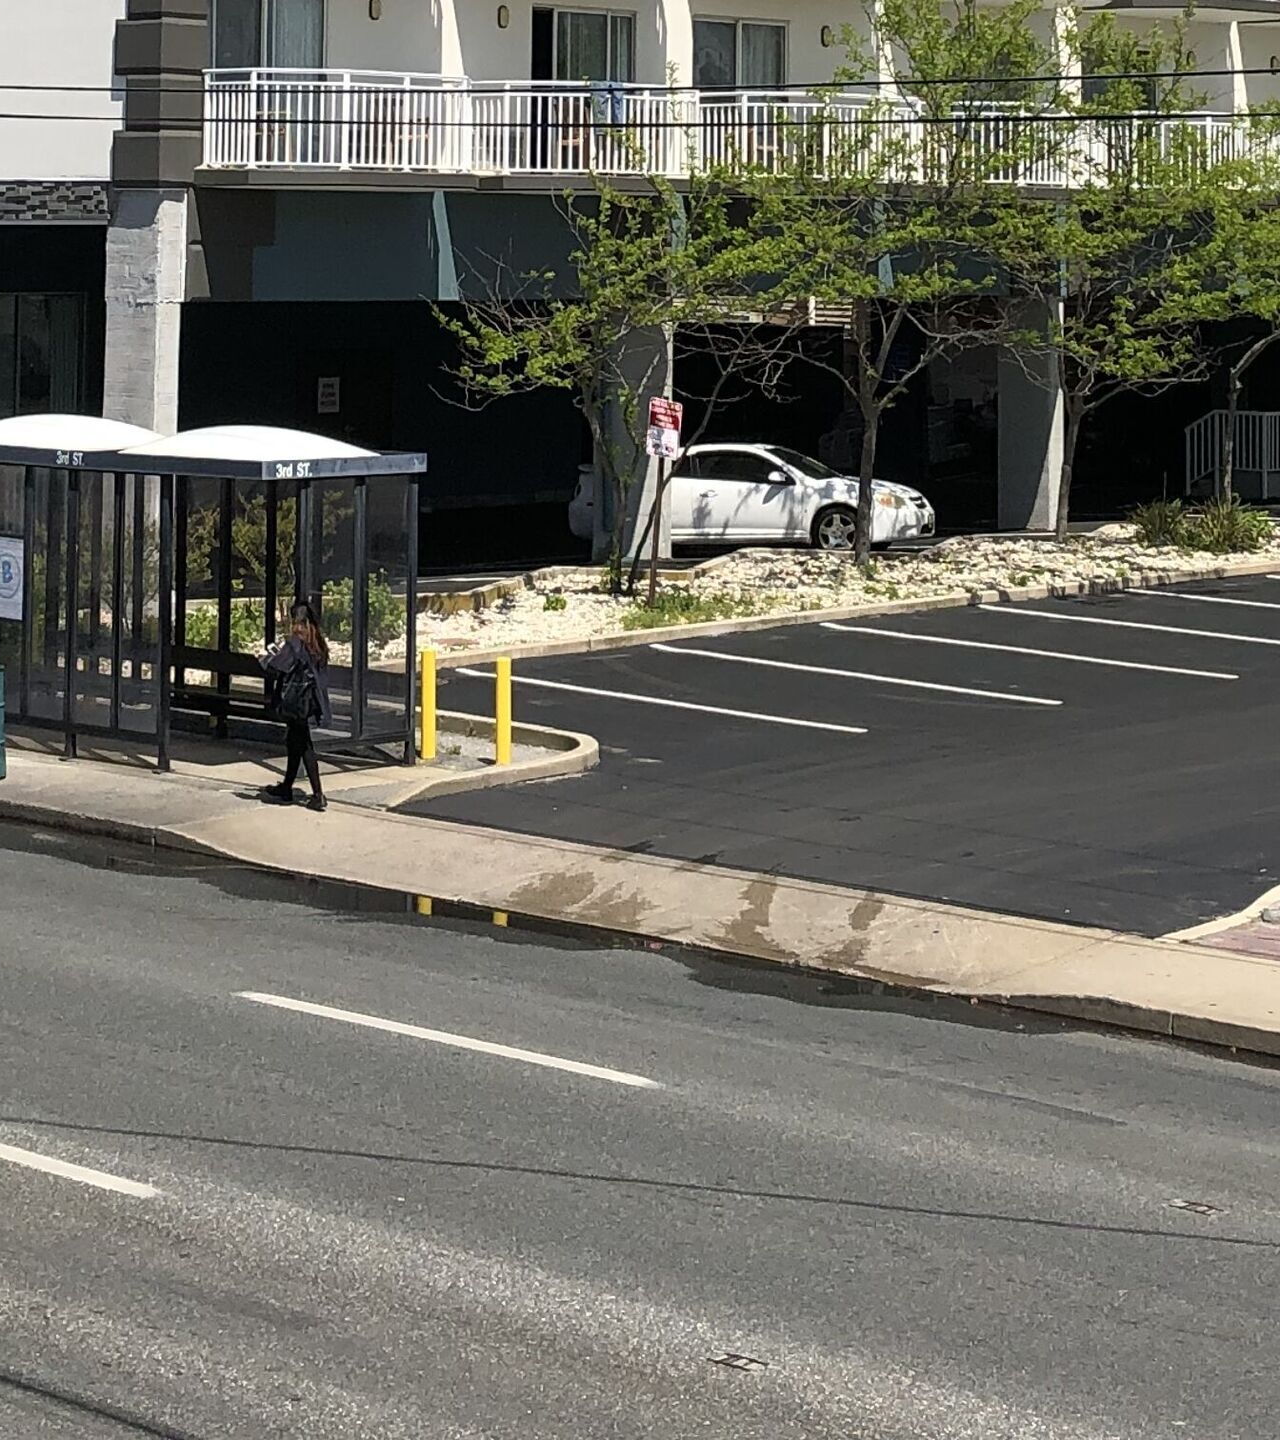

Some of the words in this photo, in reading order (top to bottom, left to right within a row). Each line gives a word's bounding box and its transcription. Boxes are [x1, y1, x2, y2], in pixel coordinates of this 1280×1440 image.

[55, 451, 69, 465] 3rd
[276, 463, 292, 478] 3rd
[296, 462, 313, 477] ST.
